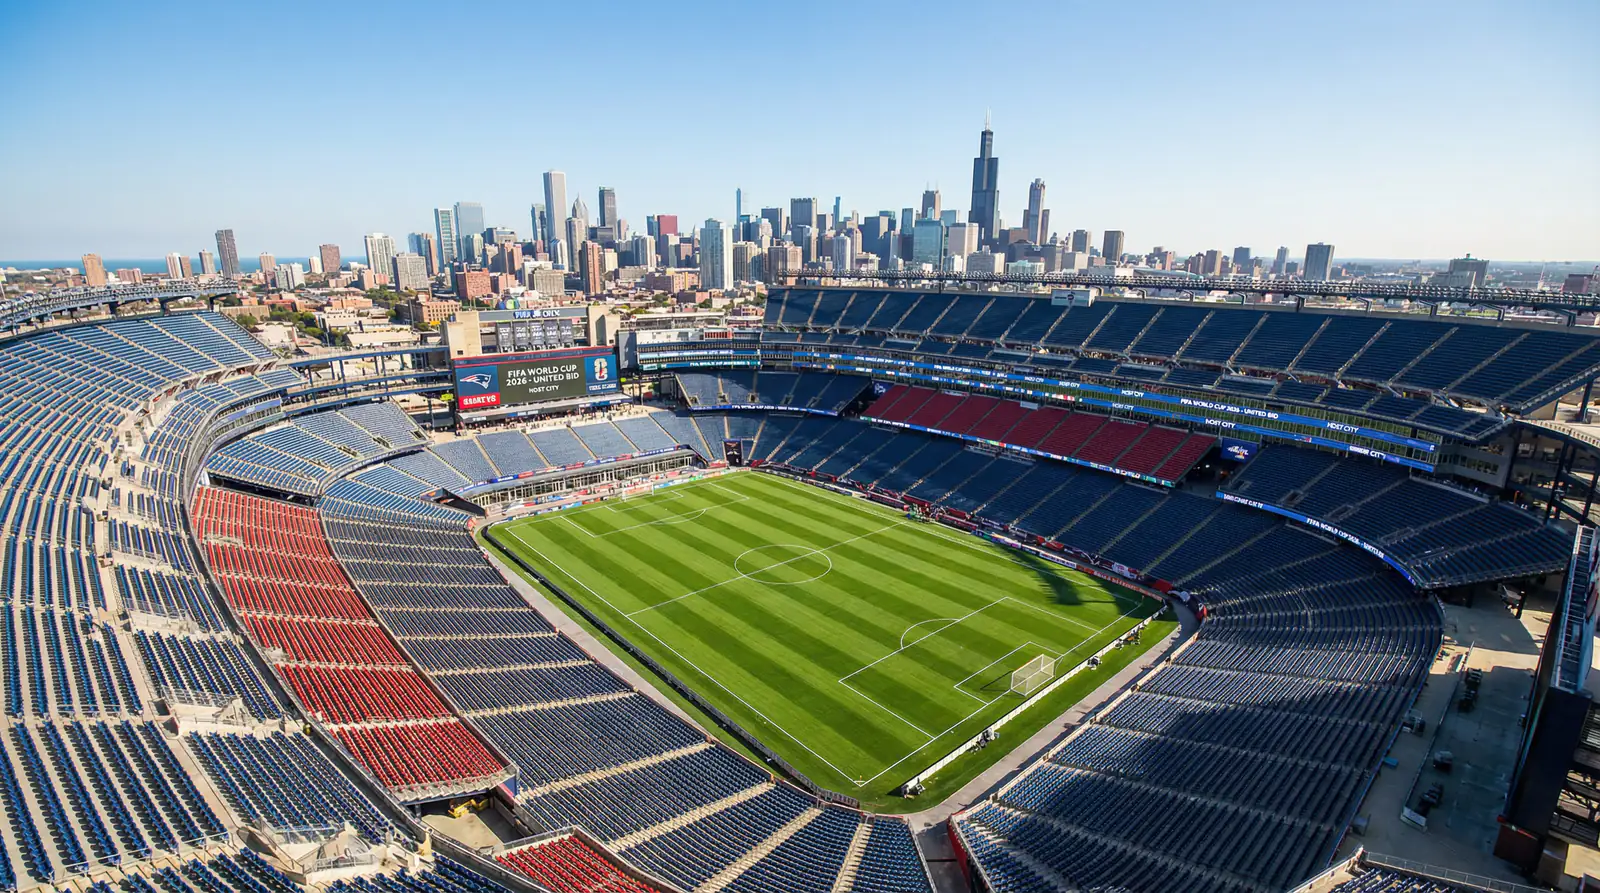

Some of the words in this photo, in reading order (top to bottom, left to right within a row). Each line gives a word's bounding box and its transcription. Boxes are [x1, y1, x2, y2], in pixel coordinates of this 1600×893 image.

[508, 369, 526, 378] FIFA
[527, 366, 559, 376] WORLD
[560, 364, 577, 372] CUP
[506, 377, 527, 386] 2026
[533, 373, 564, 383] UNITED
[566, 372, 580, 380] BID
[1193, 400, 1214, 408] WORLD
[1244, 408, 1266, 417] UNITED
[1344, 425, 1359, 433] CITY
